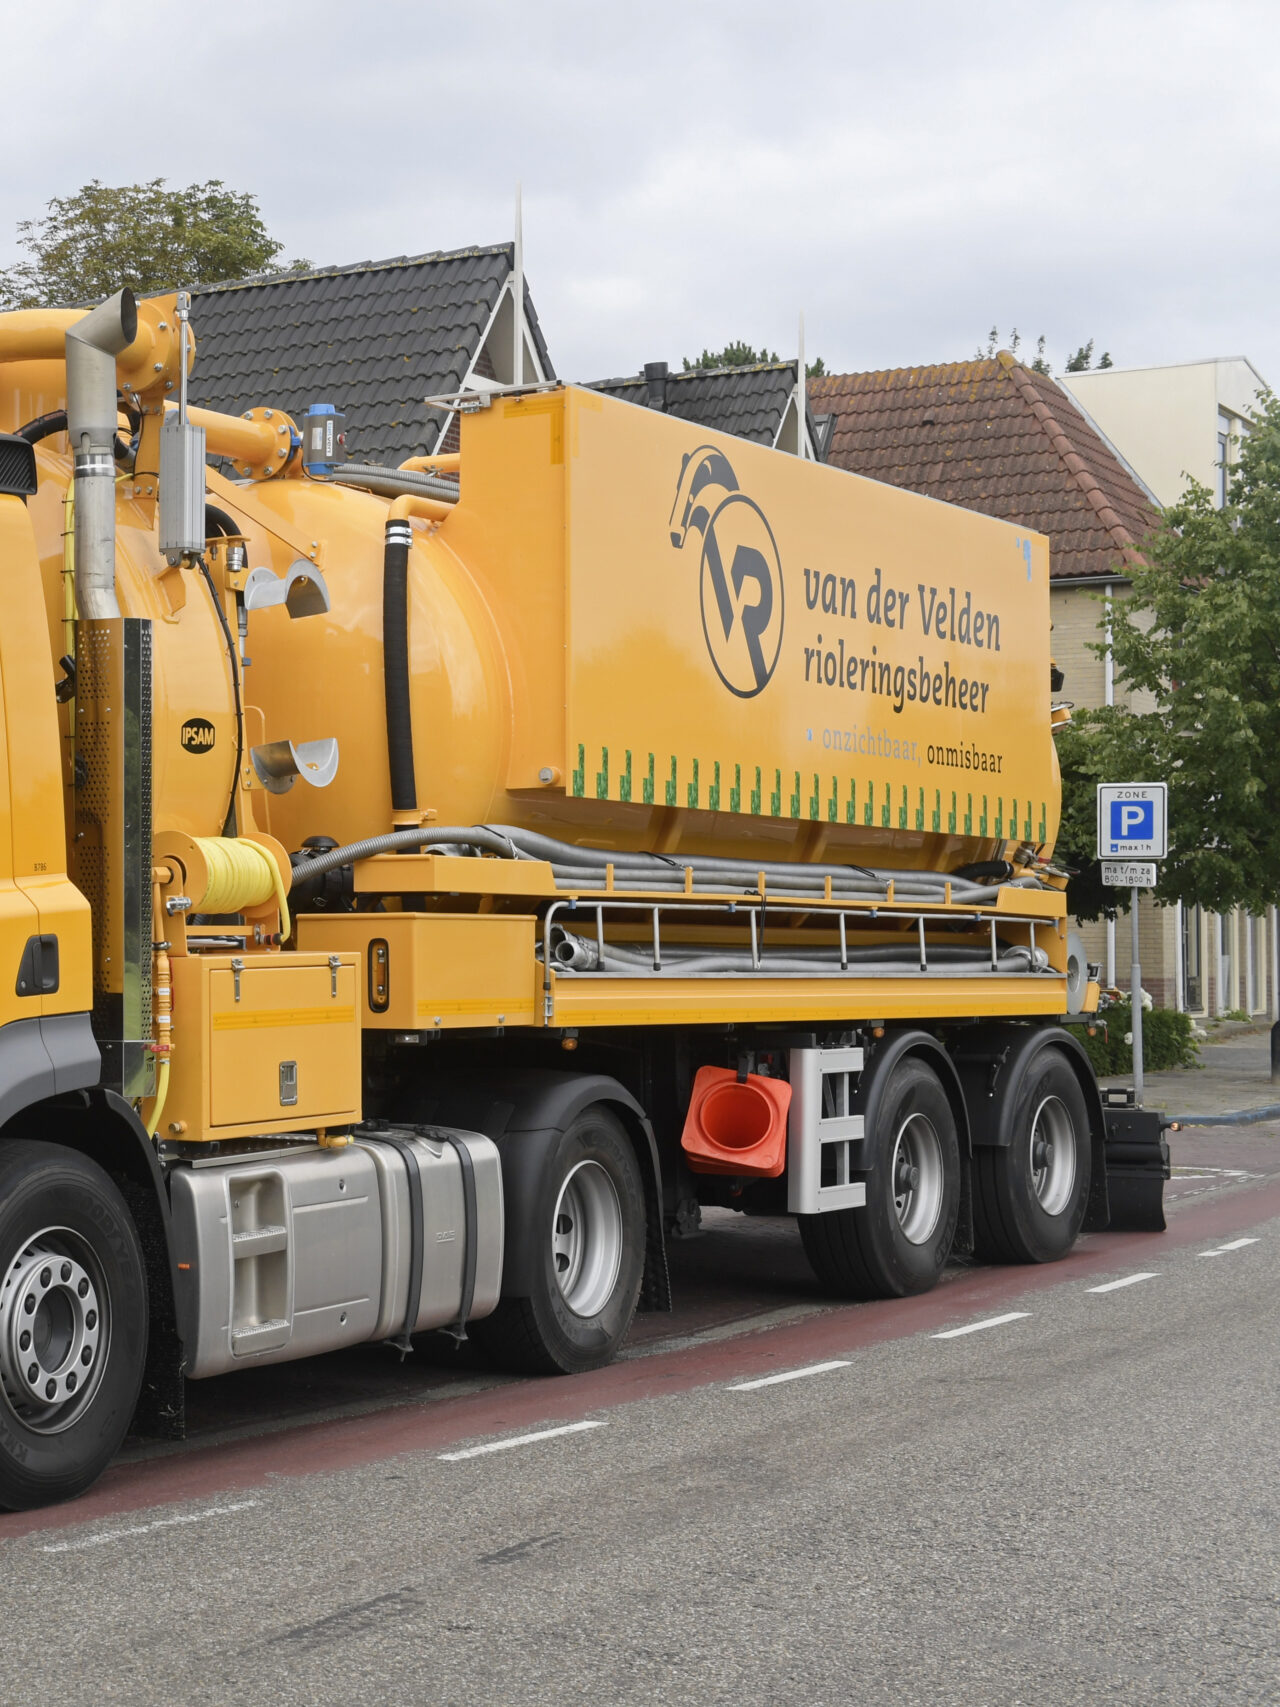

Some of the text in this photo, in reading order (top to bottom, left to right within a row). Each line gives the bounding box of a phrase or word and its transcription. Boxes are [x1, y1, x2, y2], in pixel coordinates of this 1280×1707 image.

[803, 567, 1001, 652] van der Velden
[804, 633, 990, 714] rioleringsbeheer
[182, 726, 214, 746] IPSAM
[926, 741, 1004, 774] onmisbaar
[1116, 790, 1148, 799] ZONE
[1119, 843, 1138, 851] max
[1104, 865, 1151, 875] ma t/m za
